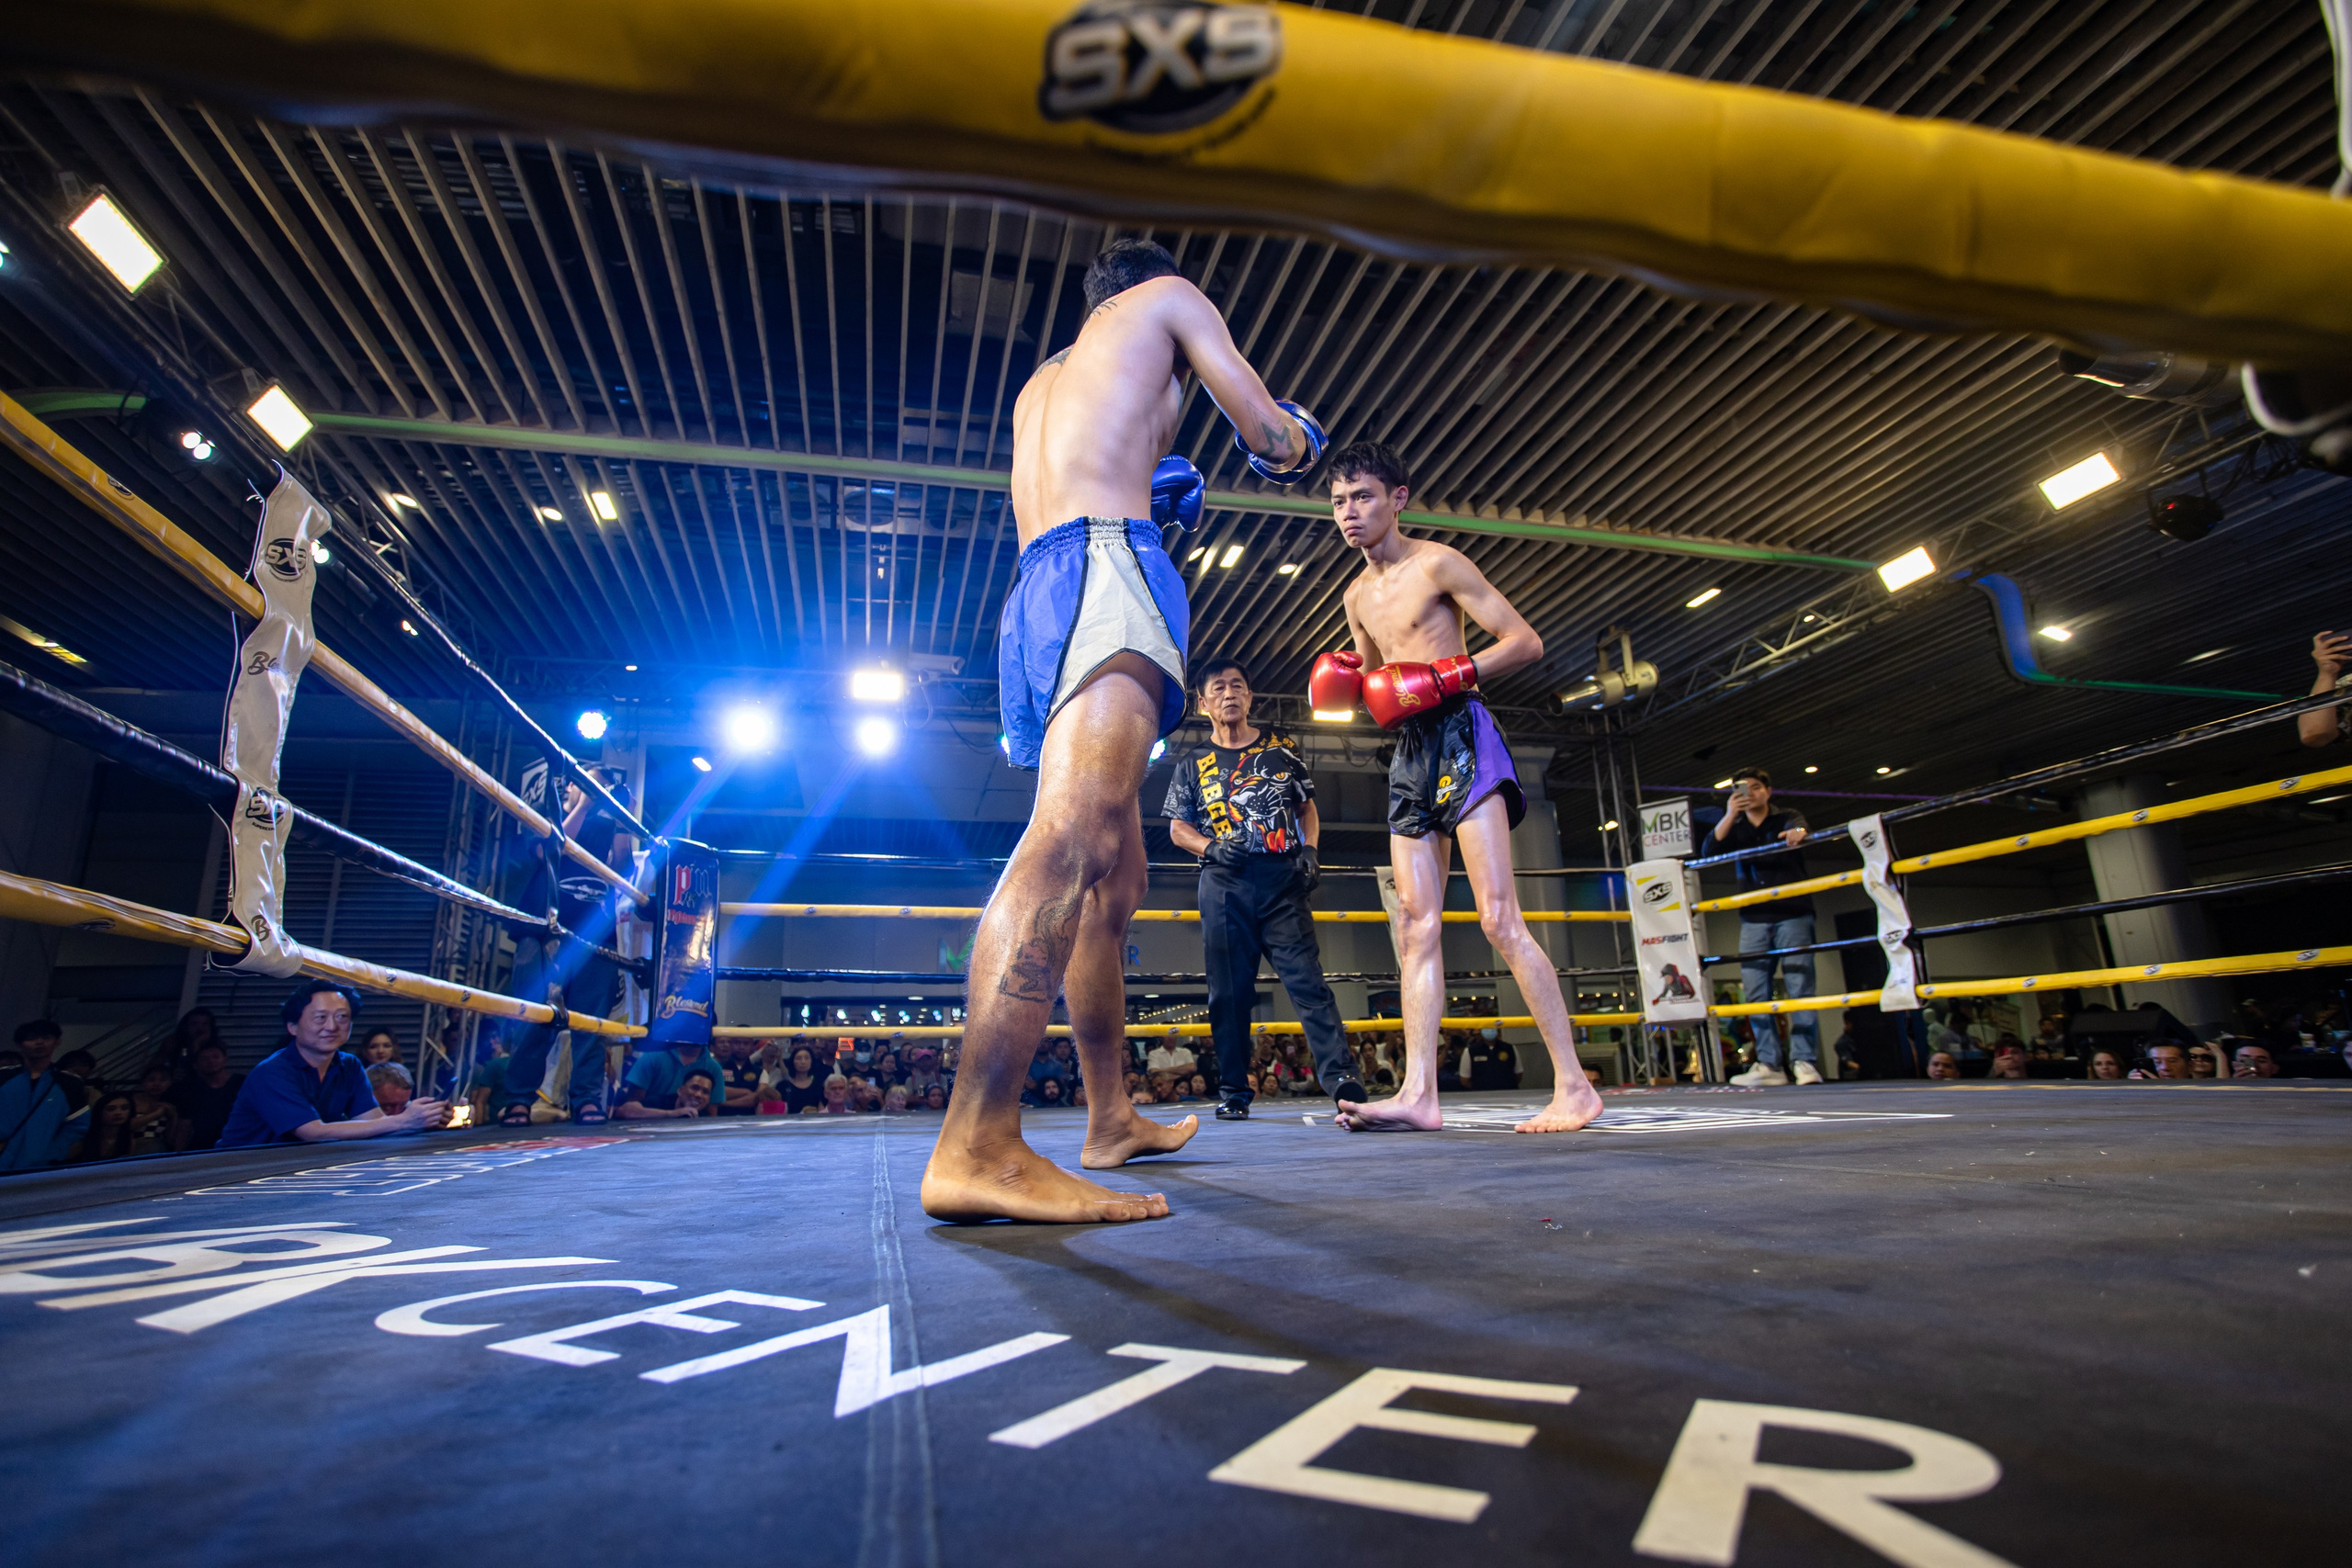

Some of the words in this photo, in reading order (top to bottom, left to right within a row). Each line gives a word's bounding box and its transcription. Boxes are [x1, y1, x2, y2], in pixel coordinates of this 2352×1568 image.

[1047, 6, 1277, 111] SXS
[265, 544, 307, 570] SXS
[1196, 751, 1233, 840] BLEGE
[1642, 810, 1689, 834] MBK
[1643, 828, 1691, 848] CENTER
[1644, 882, 1672, 903] SXS
[374, 1280, 2024, 1568] CENTER
